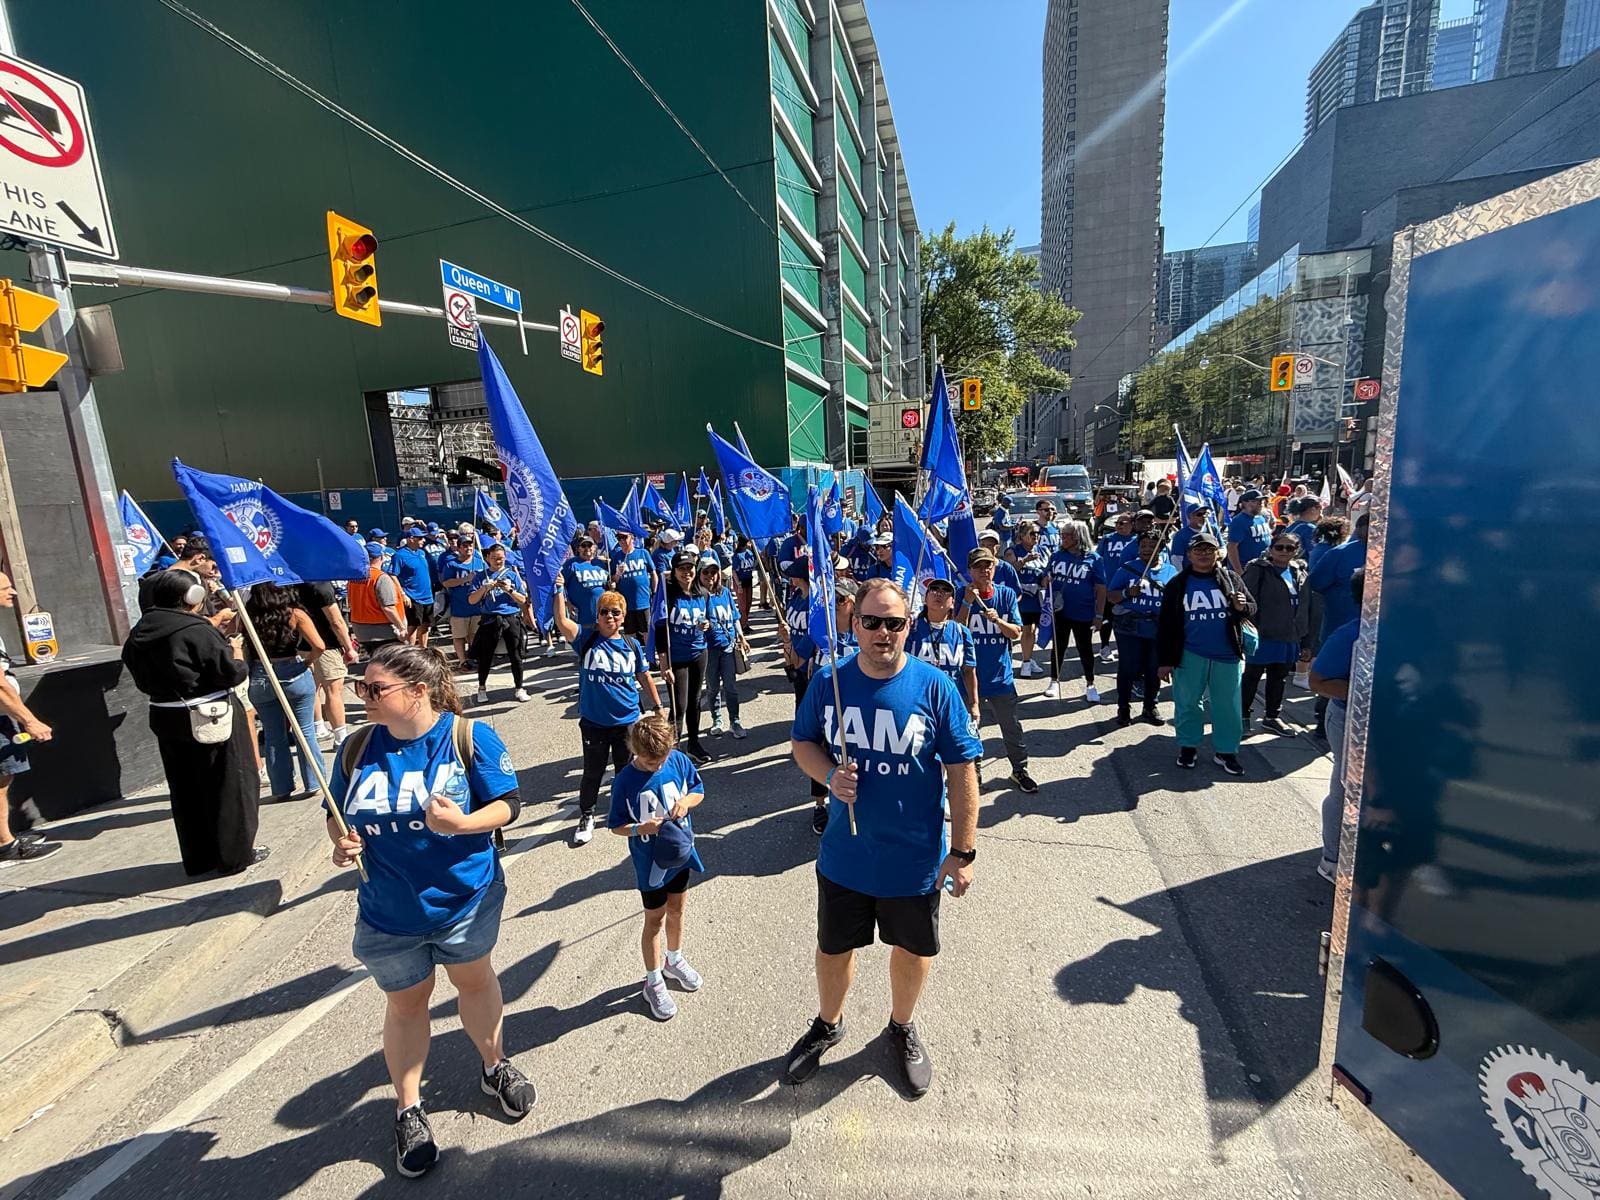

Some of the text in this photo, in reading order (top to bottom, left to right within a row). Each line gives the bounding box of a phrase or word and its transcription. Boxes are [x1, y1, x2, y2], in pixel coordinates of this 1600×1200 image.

[0, 181, 47, 209] HIS
[451, 267, 491, 296] Queen
[504, 288, 514, 305] W
[1132, 598, 1162, 607] UNIO
[1190, 612, 1226, 620] UNIO
[973, 637, 1005, 645] NION
[584, 648, 636, 673] IAM
[824, 705, 926, 756] IAM
